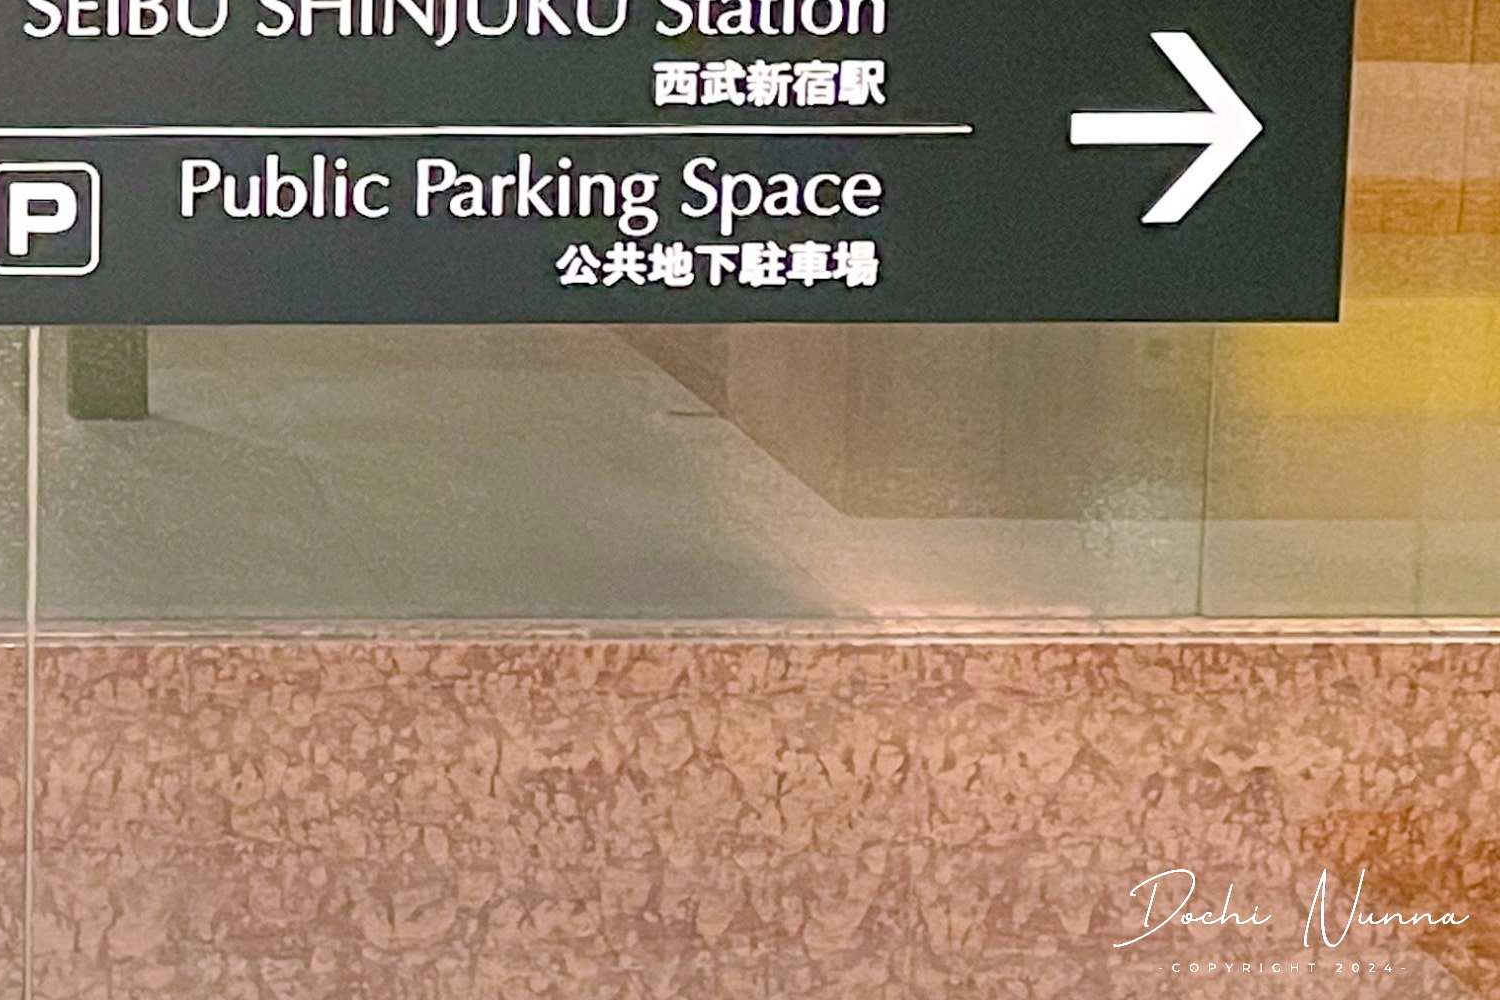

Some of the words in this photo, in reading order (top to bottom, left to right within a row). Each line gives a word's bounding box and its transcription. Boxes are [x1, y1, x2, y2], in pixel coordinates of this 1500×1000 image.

[652, 58, 886, 107] 西武新宿駅
[8, 182, 77, 256] P
[181, 154, 390, 218] Public
[416, 153, 660, 236] Parking
[681, 156, 882, 236] Space
[555, 240, 880, 288] 公共地下駐車場
